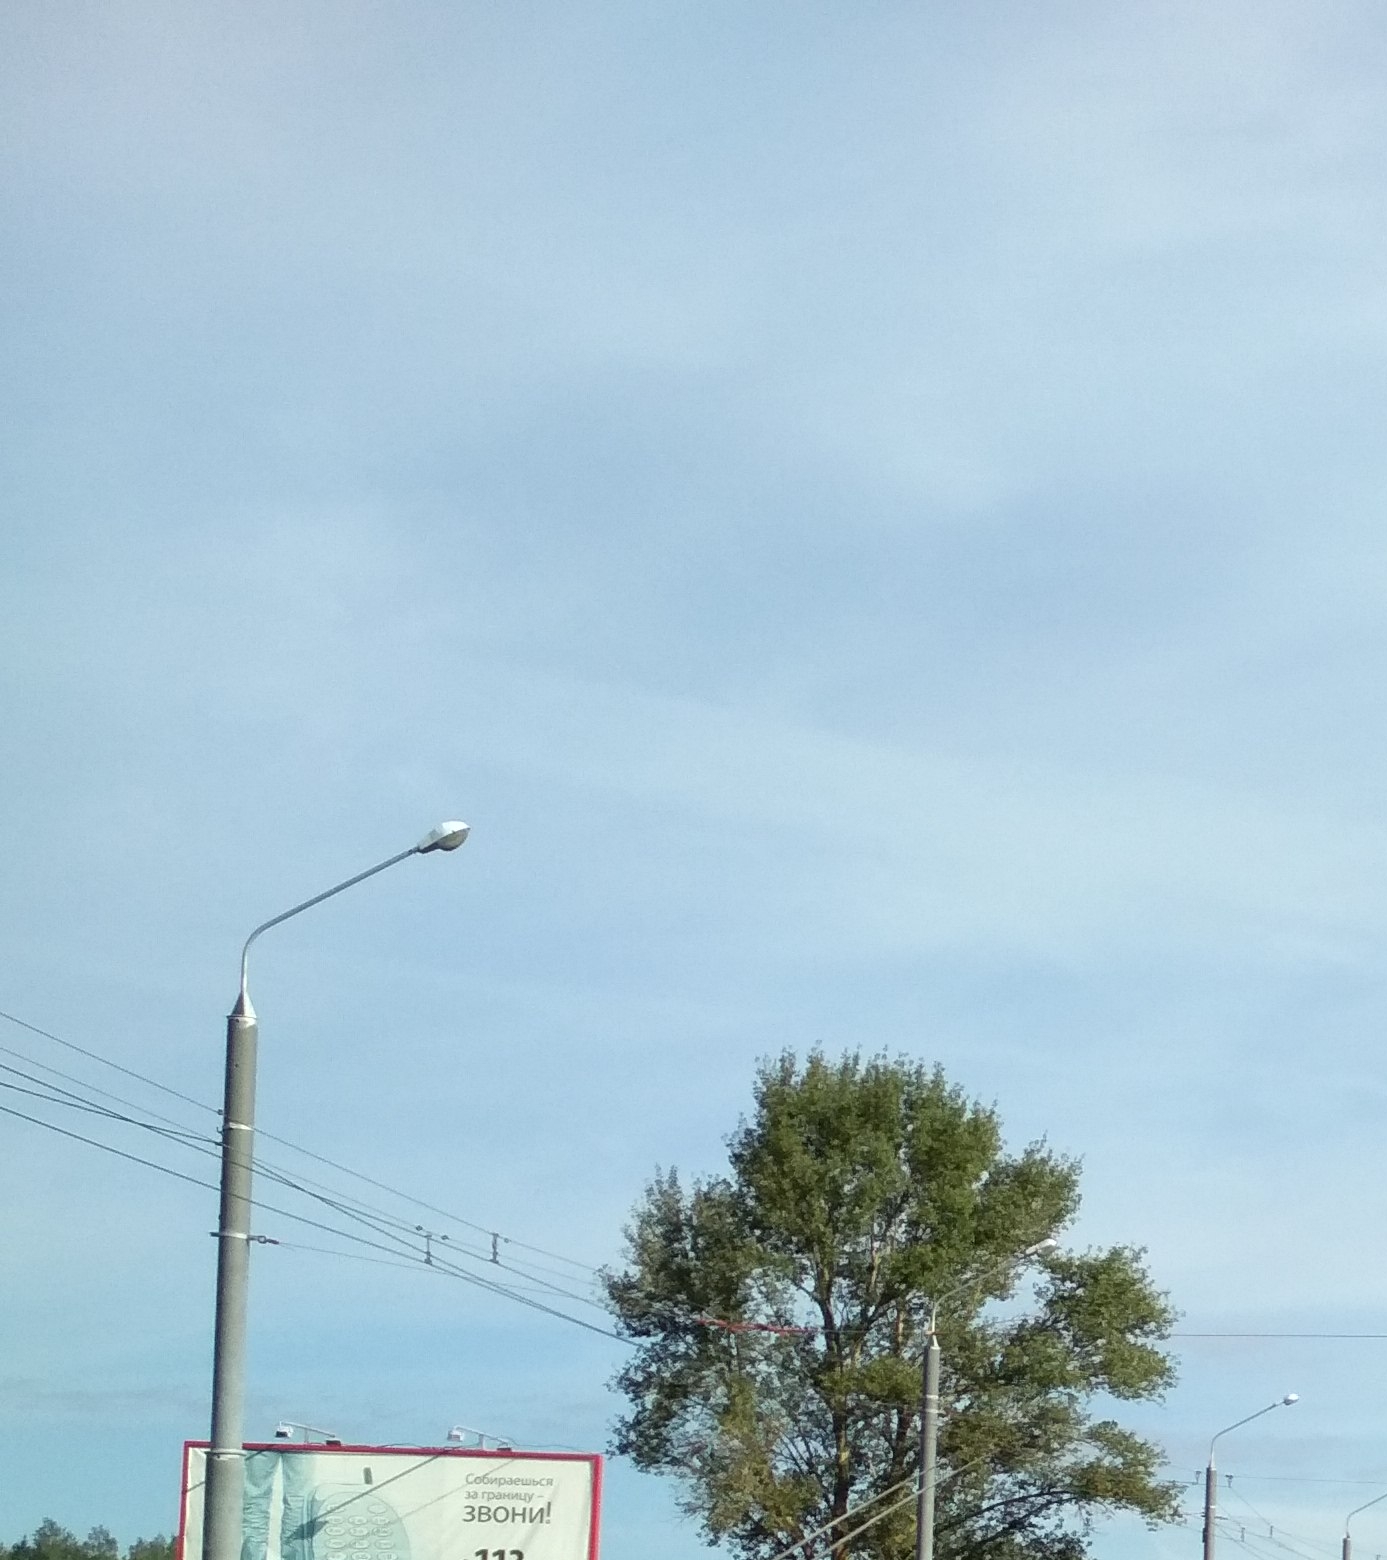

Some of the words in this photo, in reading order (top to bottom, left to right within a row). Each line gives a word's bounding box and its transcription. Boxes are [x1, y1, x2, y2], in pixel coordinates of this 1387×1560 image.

[465, 1472, 554, 1488] Собираешься
[464, 1490, 479, 1500] за
[481, 1490, 535, 1504] границу
[462, 1501, 551, 1525] ЗВОНИ!
